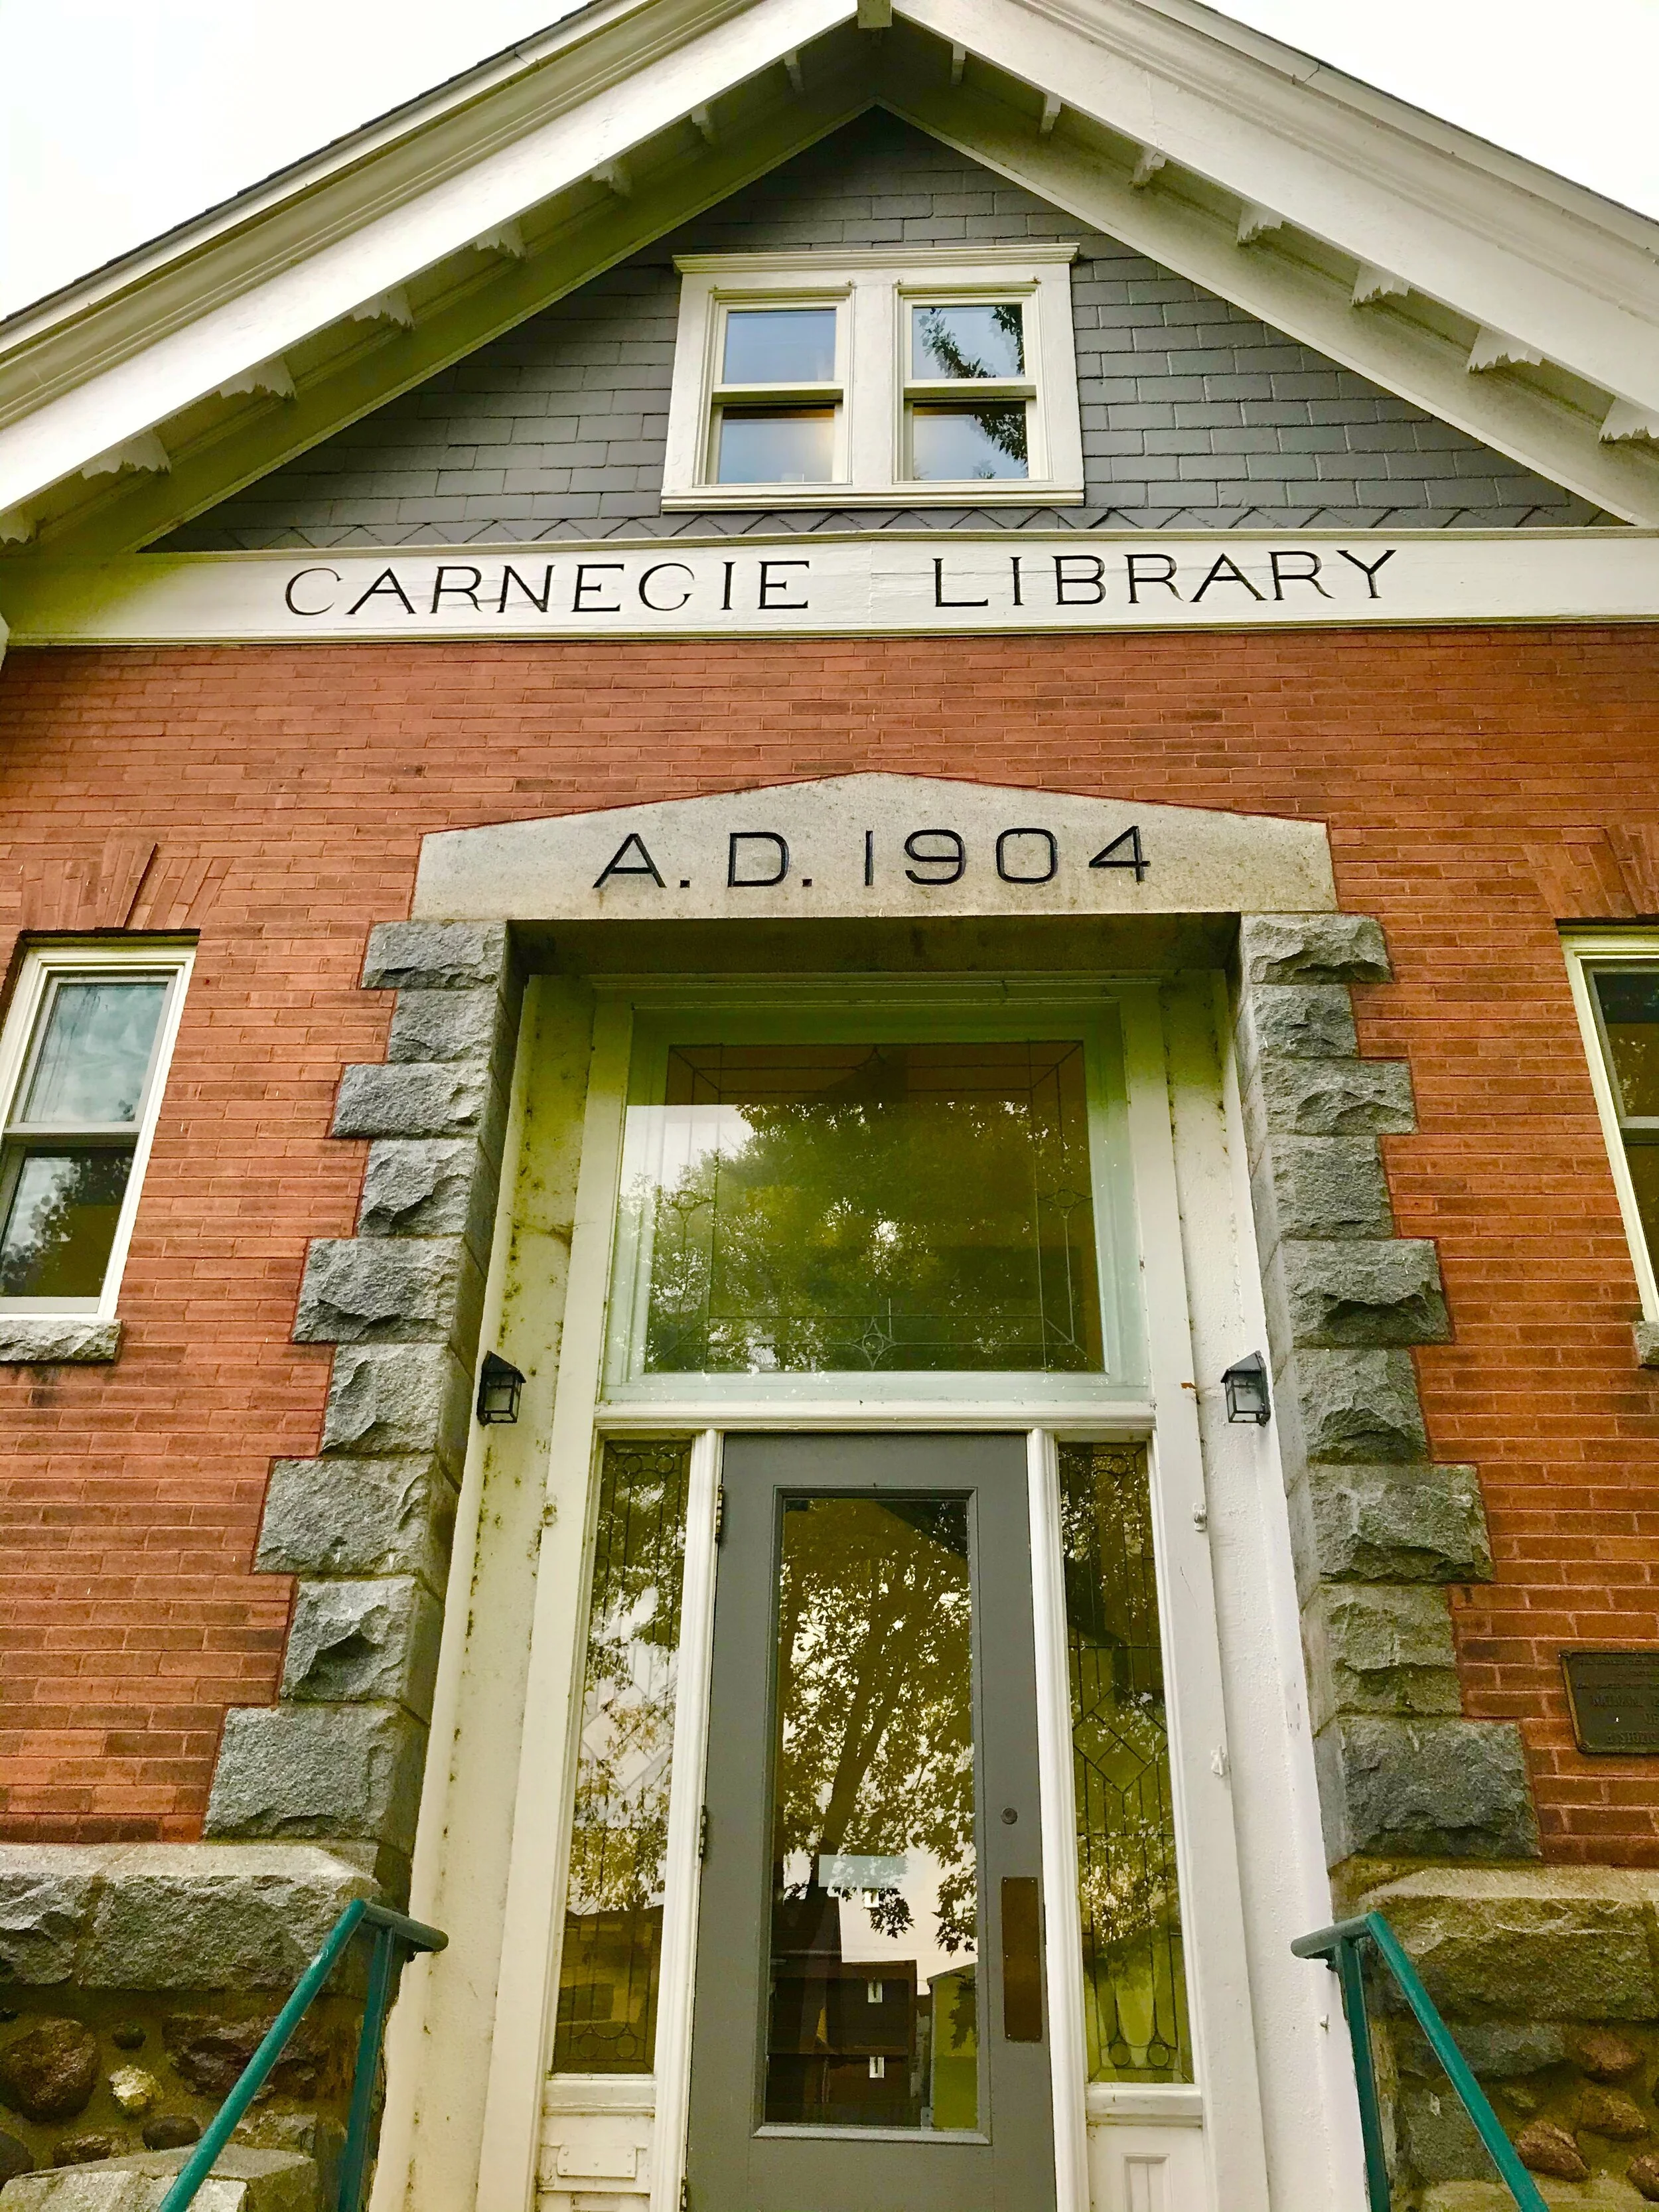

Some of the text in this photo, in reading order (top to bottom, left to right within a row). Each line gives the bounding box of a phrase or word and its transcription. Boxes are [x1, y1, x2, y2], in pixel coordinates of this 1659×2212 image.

[285, 549, 1398, 616] CARNEGIE LIBRARY
[864, 824, 1152, 887] 1904
